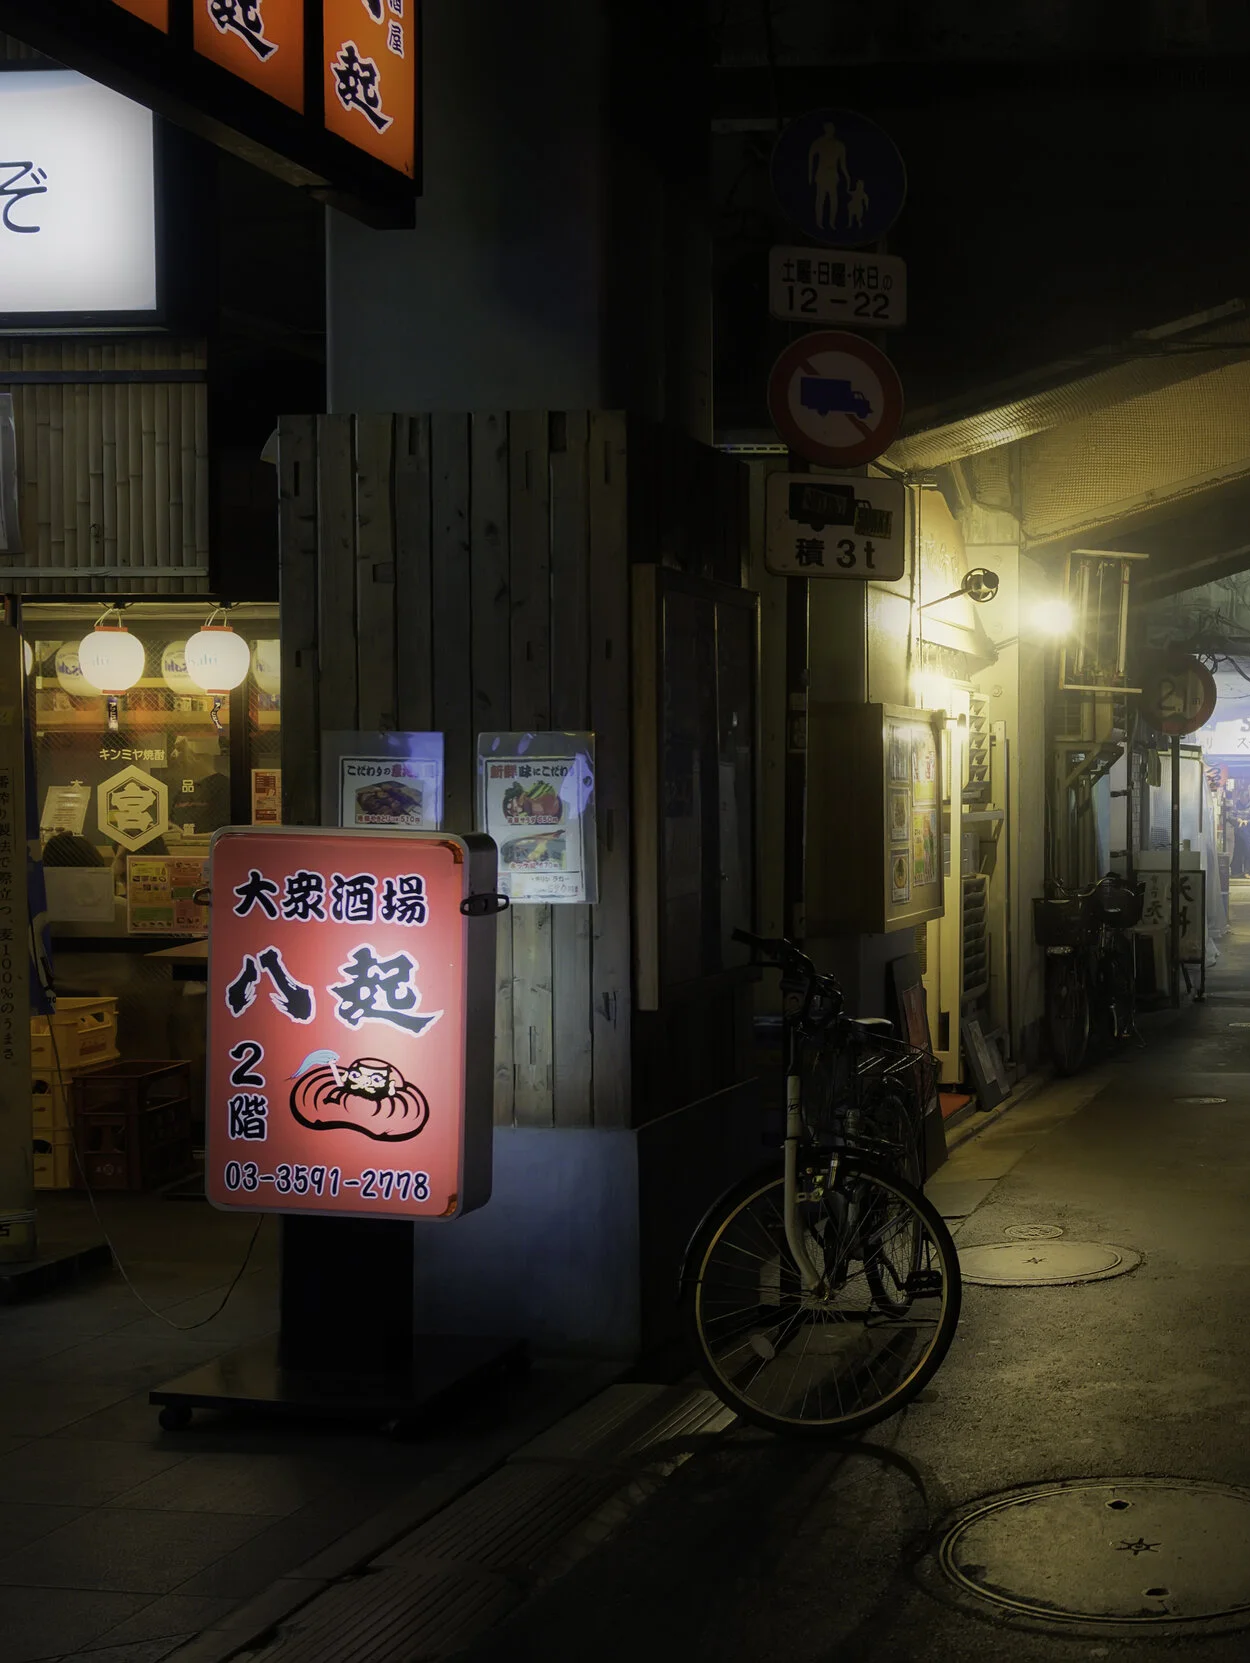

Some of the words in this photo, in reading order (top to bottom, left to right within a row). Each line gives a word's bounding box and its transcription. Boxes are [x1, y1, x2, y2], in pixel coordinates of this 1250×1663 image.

[232, 868, 428, 926] 大衆酒場
[225, 943, 444, 1038] 八起
[228, 1040, 269, 1141] 2階
[224, 1161, 430, 1201] 03-3591-2778
